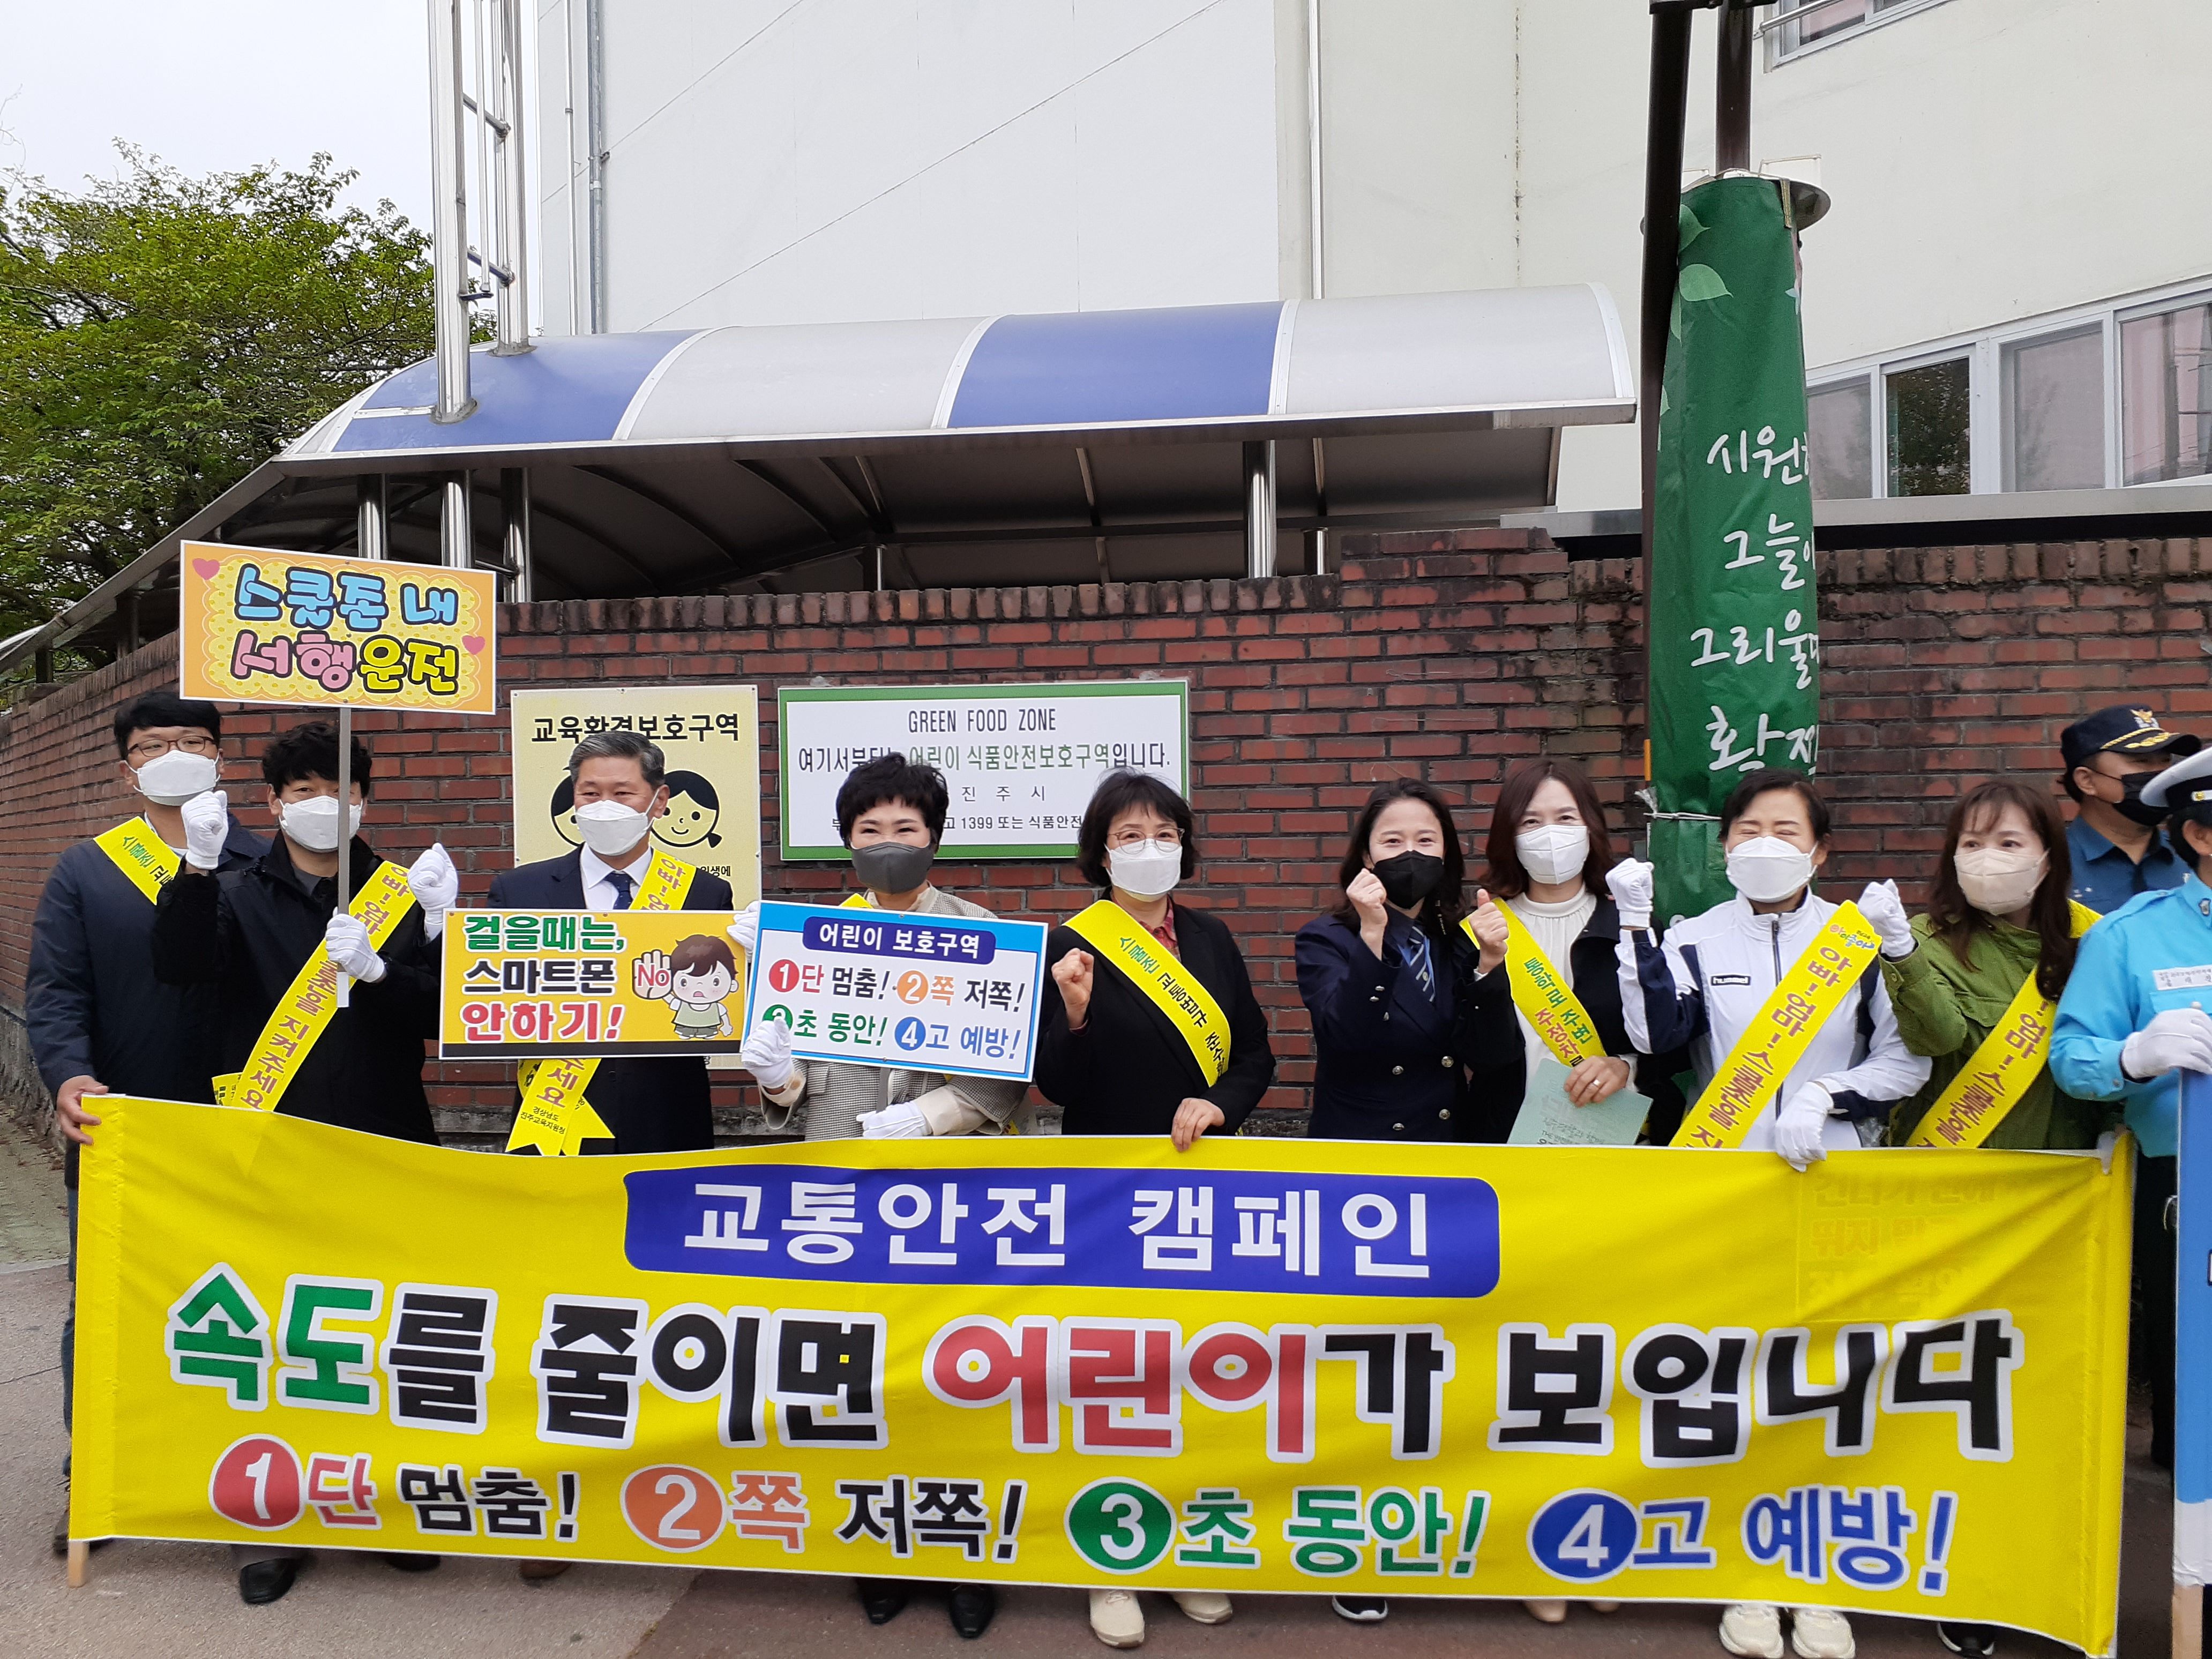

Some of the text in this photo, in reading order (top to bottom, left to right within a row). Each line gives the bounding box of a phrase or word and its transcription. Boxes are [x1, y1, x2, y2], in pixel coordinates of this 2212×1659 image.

[235, 564, 459, 632] 스쿨존 내
[230, 630, 460, 695] 서행운전
[532, 713, 739, 744] 교육환경보호구역
[909, 708, 1056, 733] GREEN FOOD ZONE
[798, 742, 1170, 772] 여기서부 어린이 식품안전보호구역입니다.
[961, 817, 993, 829] 1399
[998, 816, 1023, 829] 또는
[464, 915, 625, 952] 걸을때는,
[819, 923, 980, 959] 어린이 보호구역
[463, 960, 616, 995] 스마트폰
[638, 964, 670, 988] No
[832, 967, 890, 1000] 멈춤!
[964, 979, 1026, 1013] 저쪽!
[1119, 937, 1160, 974] 스쿨존
[1156, 972, 1208, 1029] 교통법규
[1523, 957, 1593, 1044] 통학로 주변
[461, 1002, 624, 1042] 안하기!
[827, 1012, 888, 1047] 동안!
[960, 1025, 1021, 1059] 예방!
[520, 1111, 566, 1134] 진주교육지원청
[533, 1106, 559, 1122] 경상남도
[685, 1182, 1430, 1277] 교통안전 캠페인
[173, 1273, 2012, 1459] 속도를 줄이면 어린이가 보입니다
[400, 1467, 576, 1538] 멈춤!
[837, 1477, 1024, 1559] 저쪽!
[1288, 1489, 1487, 1575] 동안!
[1746, 1489, 1954, 1591] 예방!
